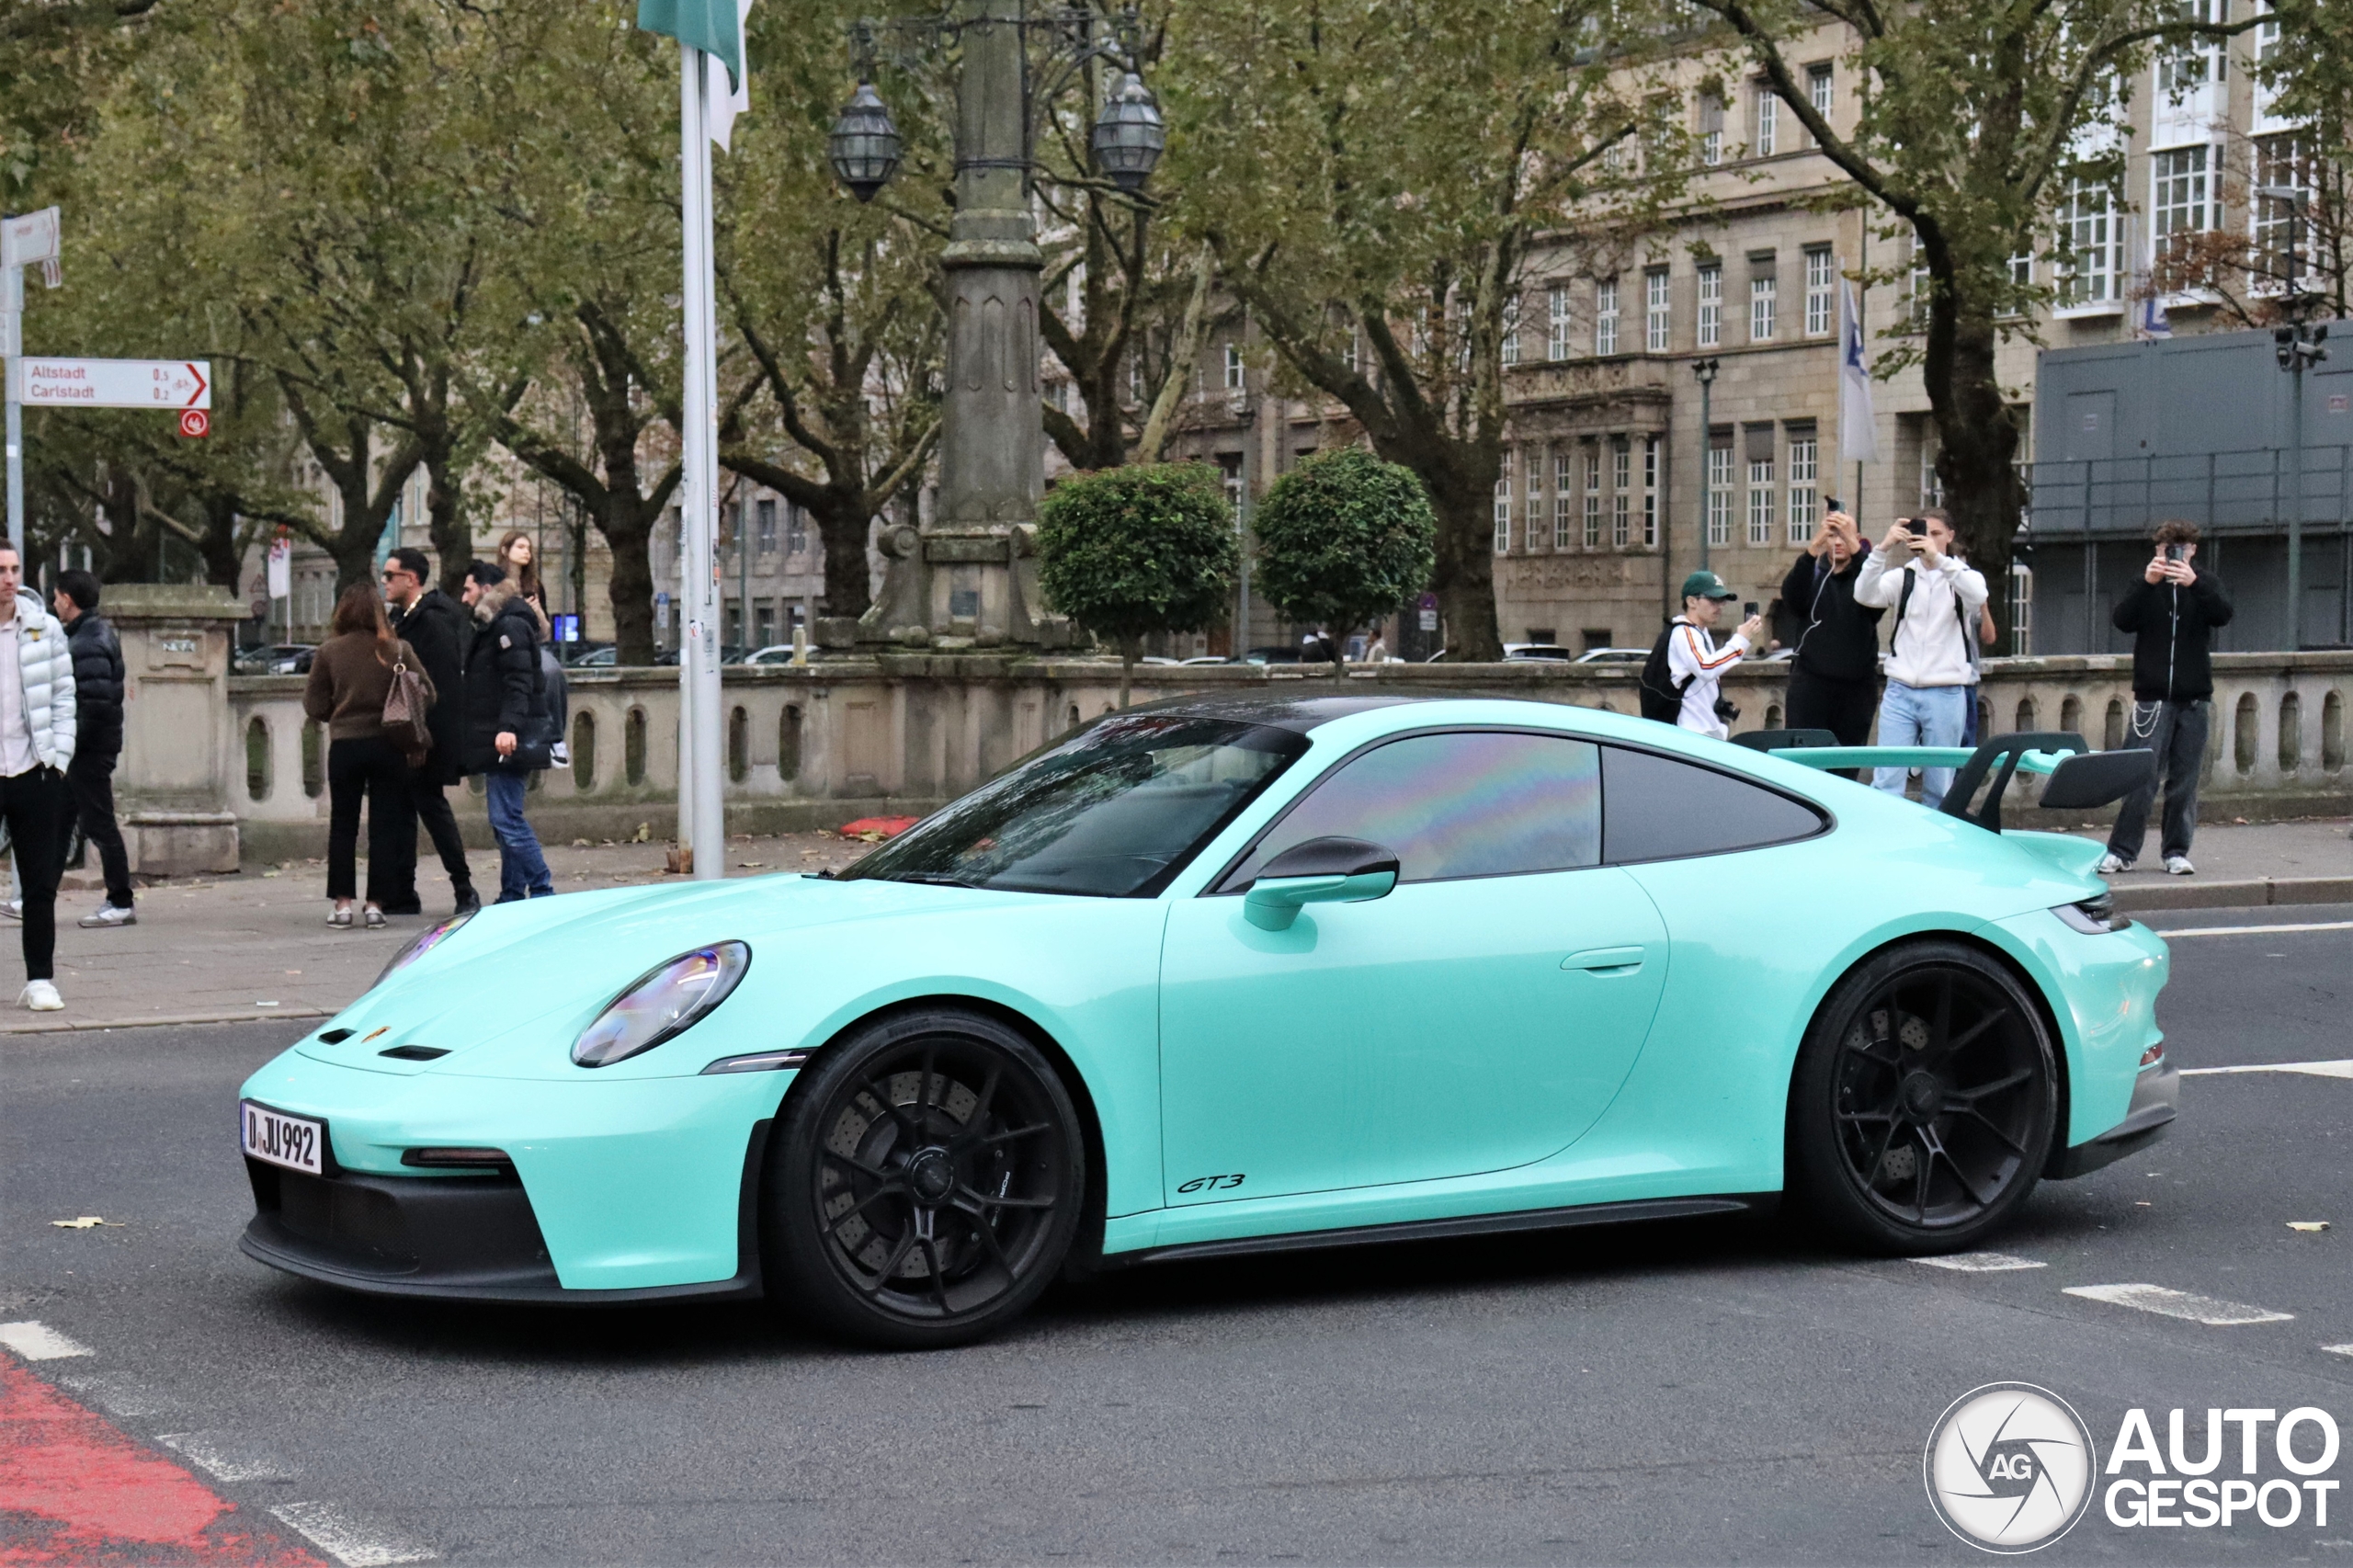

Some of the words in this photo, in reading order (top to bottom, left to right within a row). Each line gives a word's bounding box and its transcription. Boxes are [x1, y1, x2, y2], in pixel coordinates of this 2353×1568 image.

[31, 365, 85, 379] Altstadt
[31, 384, 95, 398] Carlstadt
[249, 1110, 256, 1149] D
[1177, 1174, 1245, 1193] GT3
